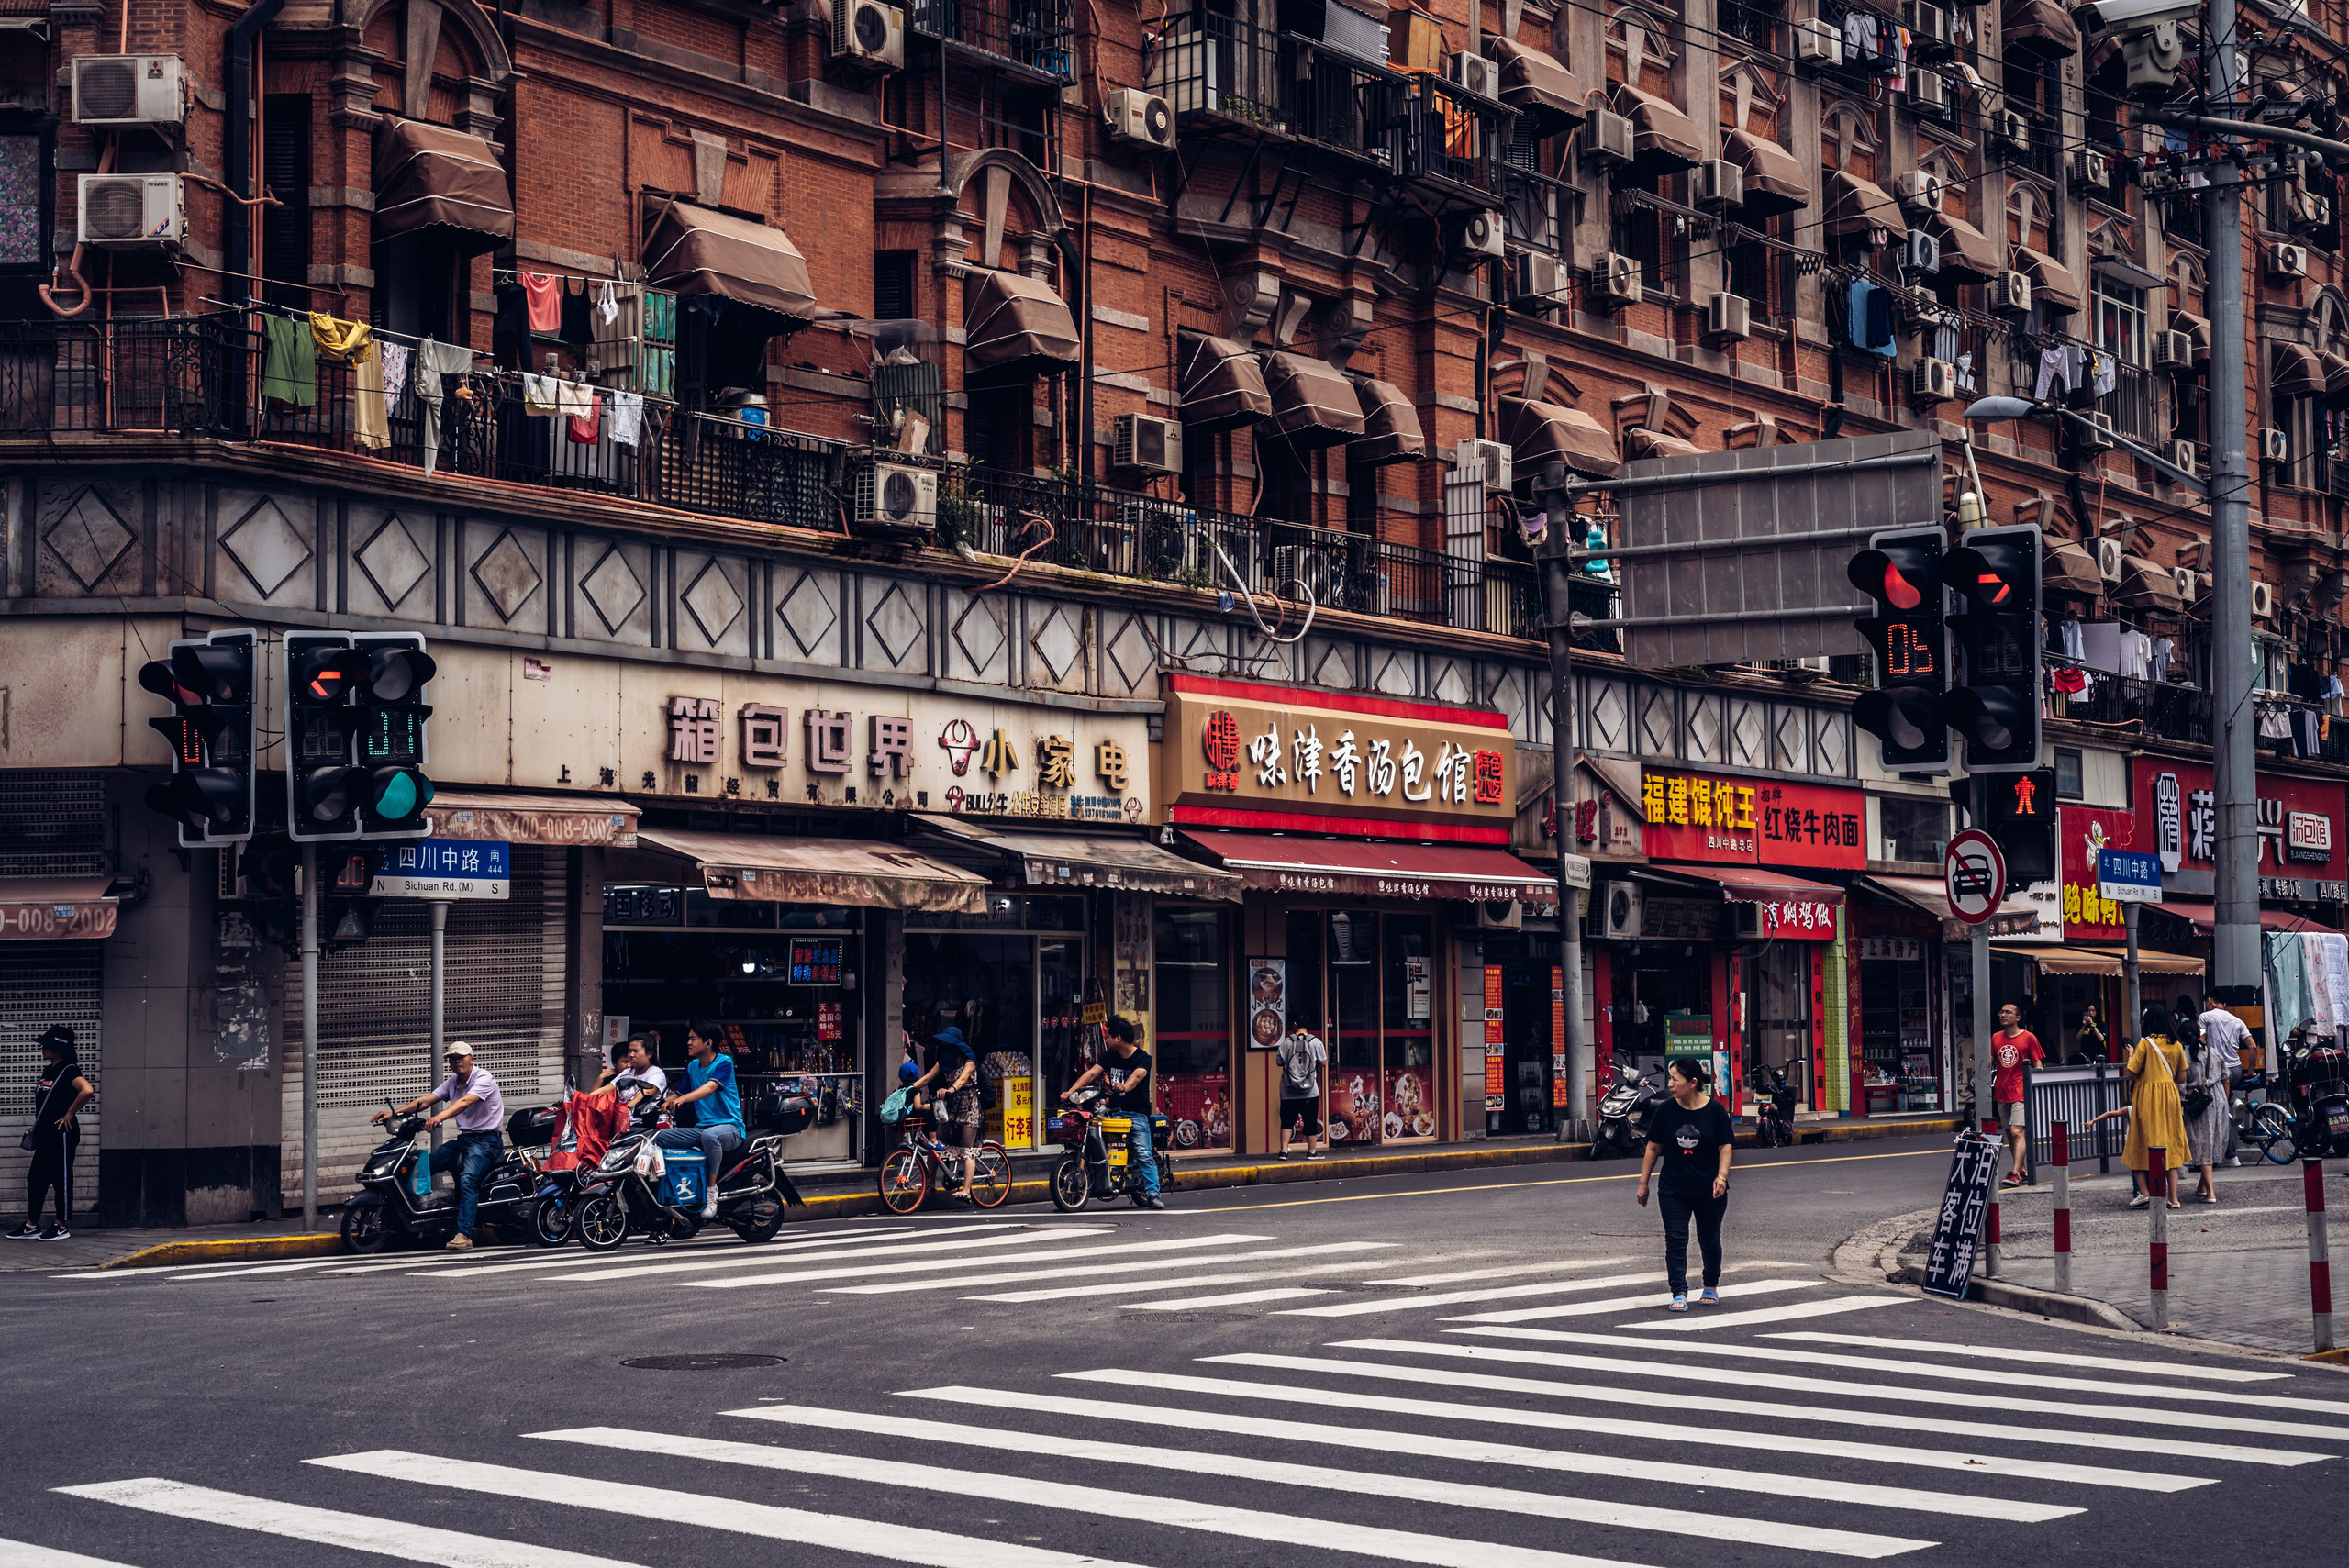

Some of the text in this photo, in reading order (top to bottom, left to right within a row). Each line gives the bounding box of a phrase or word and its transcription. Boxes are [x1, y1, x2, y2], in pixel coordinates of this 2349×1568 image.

[668, 695, 915, 778] 箱包世界
[981, 728, 1129, 791] 小家电
[1248, 721, 1472, 805] 味津香汤包馆
[1205, 772, 1239, 791] 味津香
[1641, 773, 1757, 830] 福建馄饨王
[1761, 786, 1783, 805] 招牌
[512, 817, 614, 841] 400-008-2002
[1764, 806, 1859, 848] 红烧牛肉面
[2189, 789, 2284, 865] 蒋兴
[2292, 816, 2327, 846] 汤包馆
[1708, 836, 1753, 852] 四川中路总店
[399, 846, 481, 873] 四川中路
[489, 848, 501, 863] 南
[487, 865, 503, 874] 444
[2112, 857, 2149, 881] 四川中路
[377, 879, 385, 892] N
[405, 880, 440, 892] Sichuan
[491, 883, 499, 895] S
[1287, 876, 1334, 890] 味津香汤包馆
[1386, 881, 1430, 895] 味津香汤包馆
[1476, 885, 1517, 899] 味津香汤包馆
[2105, 884, 2110, 895] N
[2117, 885, 2132, 896] Sichuan
[2153, 889, 2158, 900] S
[2276, 879, 2303, 897] 传统小吃
[2320, 882, 2347, 901] 四川路店
[1764, 901, 1831, 930] 黄焖鸡饭
[2064, 881, 2125, 927] 绝味鸭
[1848, 922, 1861, 1032] 上海特产
[1252, 995, 1285, 1013] 小笼包
[818, 1013, 842, 1022] 遮阳伞
[818, 1023, 834, 1031] 特价
[1814, 963, 1825, 1090] 红烧牛肉面
[826, 1030, 842, 1039] 35元
[1928, 1140, 1972, 1283] 大客车
[1947, 1144, 1995, 1288] 泊位满
